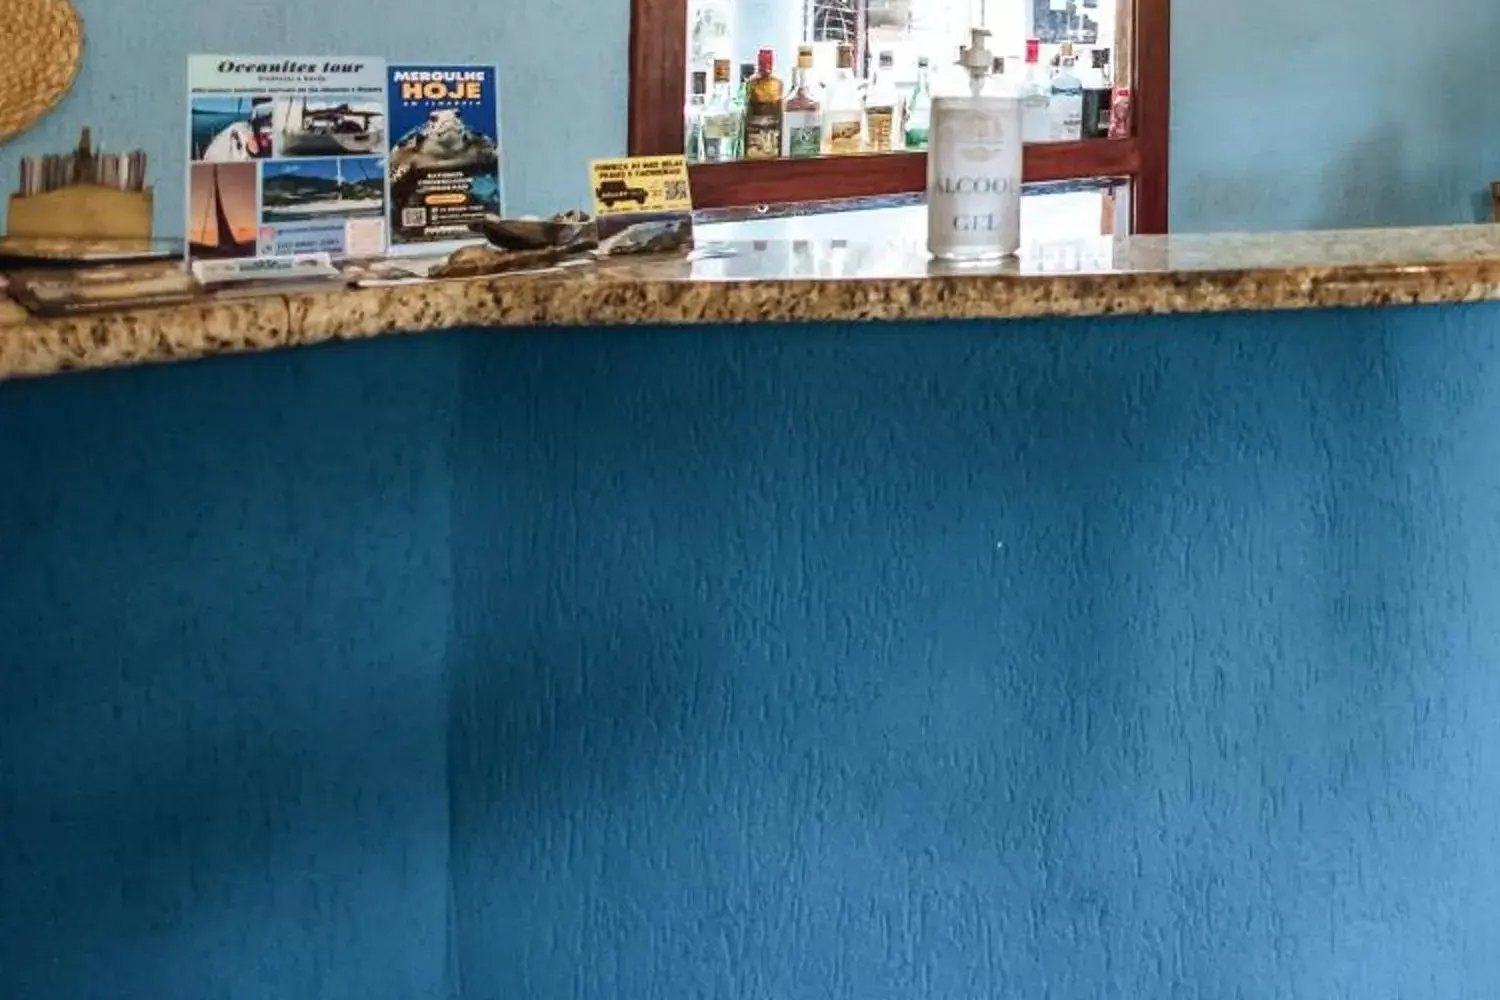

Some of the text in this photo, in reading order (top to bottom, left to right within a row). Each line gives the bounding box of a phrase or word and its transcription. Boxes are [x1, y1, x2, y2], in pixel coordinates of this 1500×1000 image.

[217, 60, 364, 74] Oceanites tour
[393, 70, 485, 83] MERGULHE
[402, 82, 481, 100] HOJE
[953, 213, 998, 231] GEL
